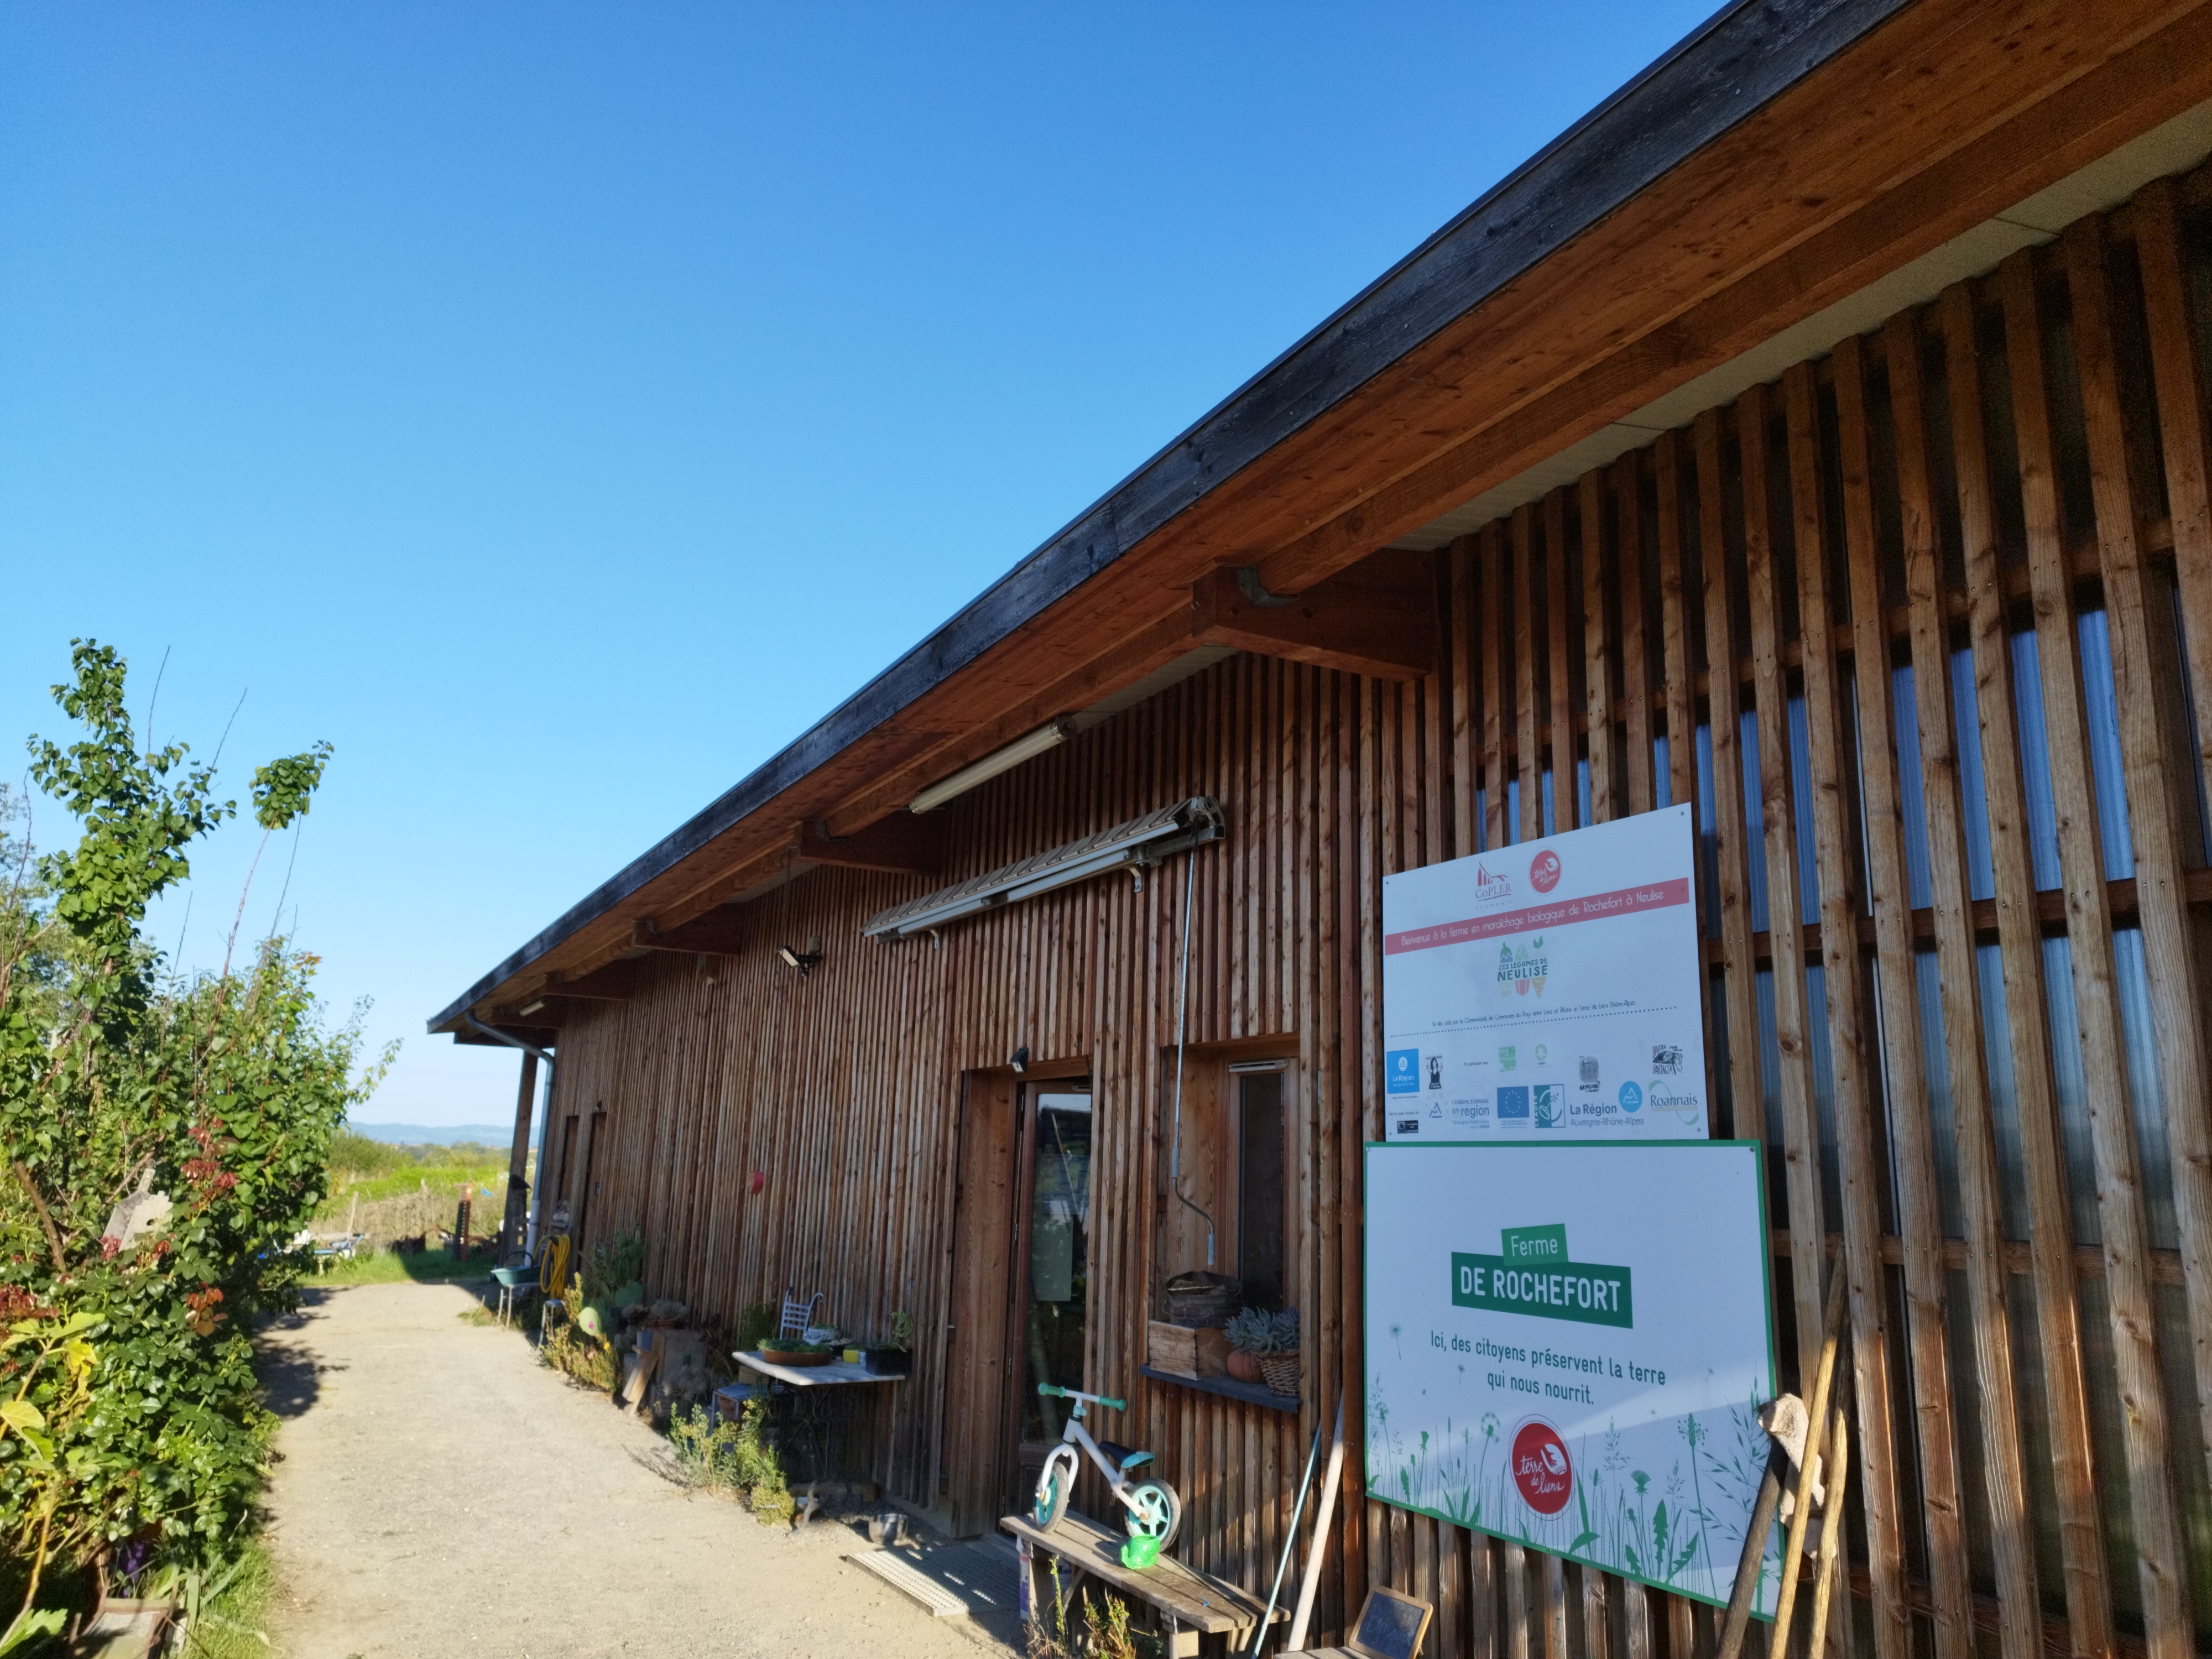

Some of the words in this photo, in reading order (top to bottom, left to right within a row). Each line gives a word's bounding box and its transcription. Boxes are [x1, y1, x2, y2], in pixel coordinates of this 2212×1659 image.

[1401, 934, 1431, 946] Bienvenue
[1441, 930, 1447, 938] la
[1449, 927, 1468, 937] ferme
[1483, 917, 1525, 930] maraîchage
[1527, 910, 1565, 924] biologique
[1569, 904, 1579, 915] de
[1583, 897, 1622, 912] Rochefort
[1626, 894, 1632, 905] à
[1636, 889, 1663, 903] Neulise
[1498, 965, 1548, 982] NEULISE
[1570, 1104, 1580, 1115] La
[1583, 1103, 1618, 1117] Région
[1650, 1092, 1698, 1107] Roannais
[1571, 1117, 1644, 1128] Auvergne-Rhône-Alpes
[1511, 1235, 1558, 1257] Ferme
[1460, 1266, 1485, 1296] DE
[1493, 1270, 1621, 1312] ROCHEFORT
[1431, 1330, 1447, 1352] Ici,
[1452, 1334, 1471, 1352] des
[1475, 1338, 1526, 1363] citoyens
[1531, 1348, 1603, 1375] préservent
[1610, 1358, 1623, 1378] la
[1629, 1360, 1666, 1385] terre
[1488, 1370, 1505, 1391] qui
[1510, 1376, 1540, 1394] nous
[1545, 1384, 1594, 1405] nourrit.
[1515, 1455, 1543, 1475] terre
[1531, 1473, 1539, 1486] de
[1535, 1472, 1566, 1494] liens
